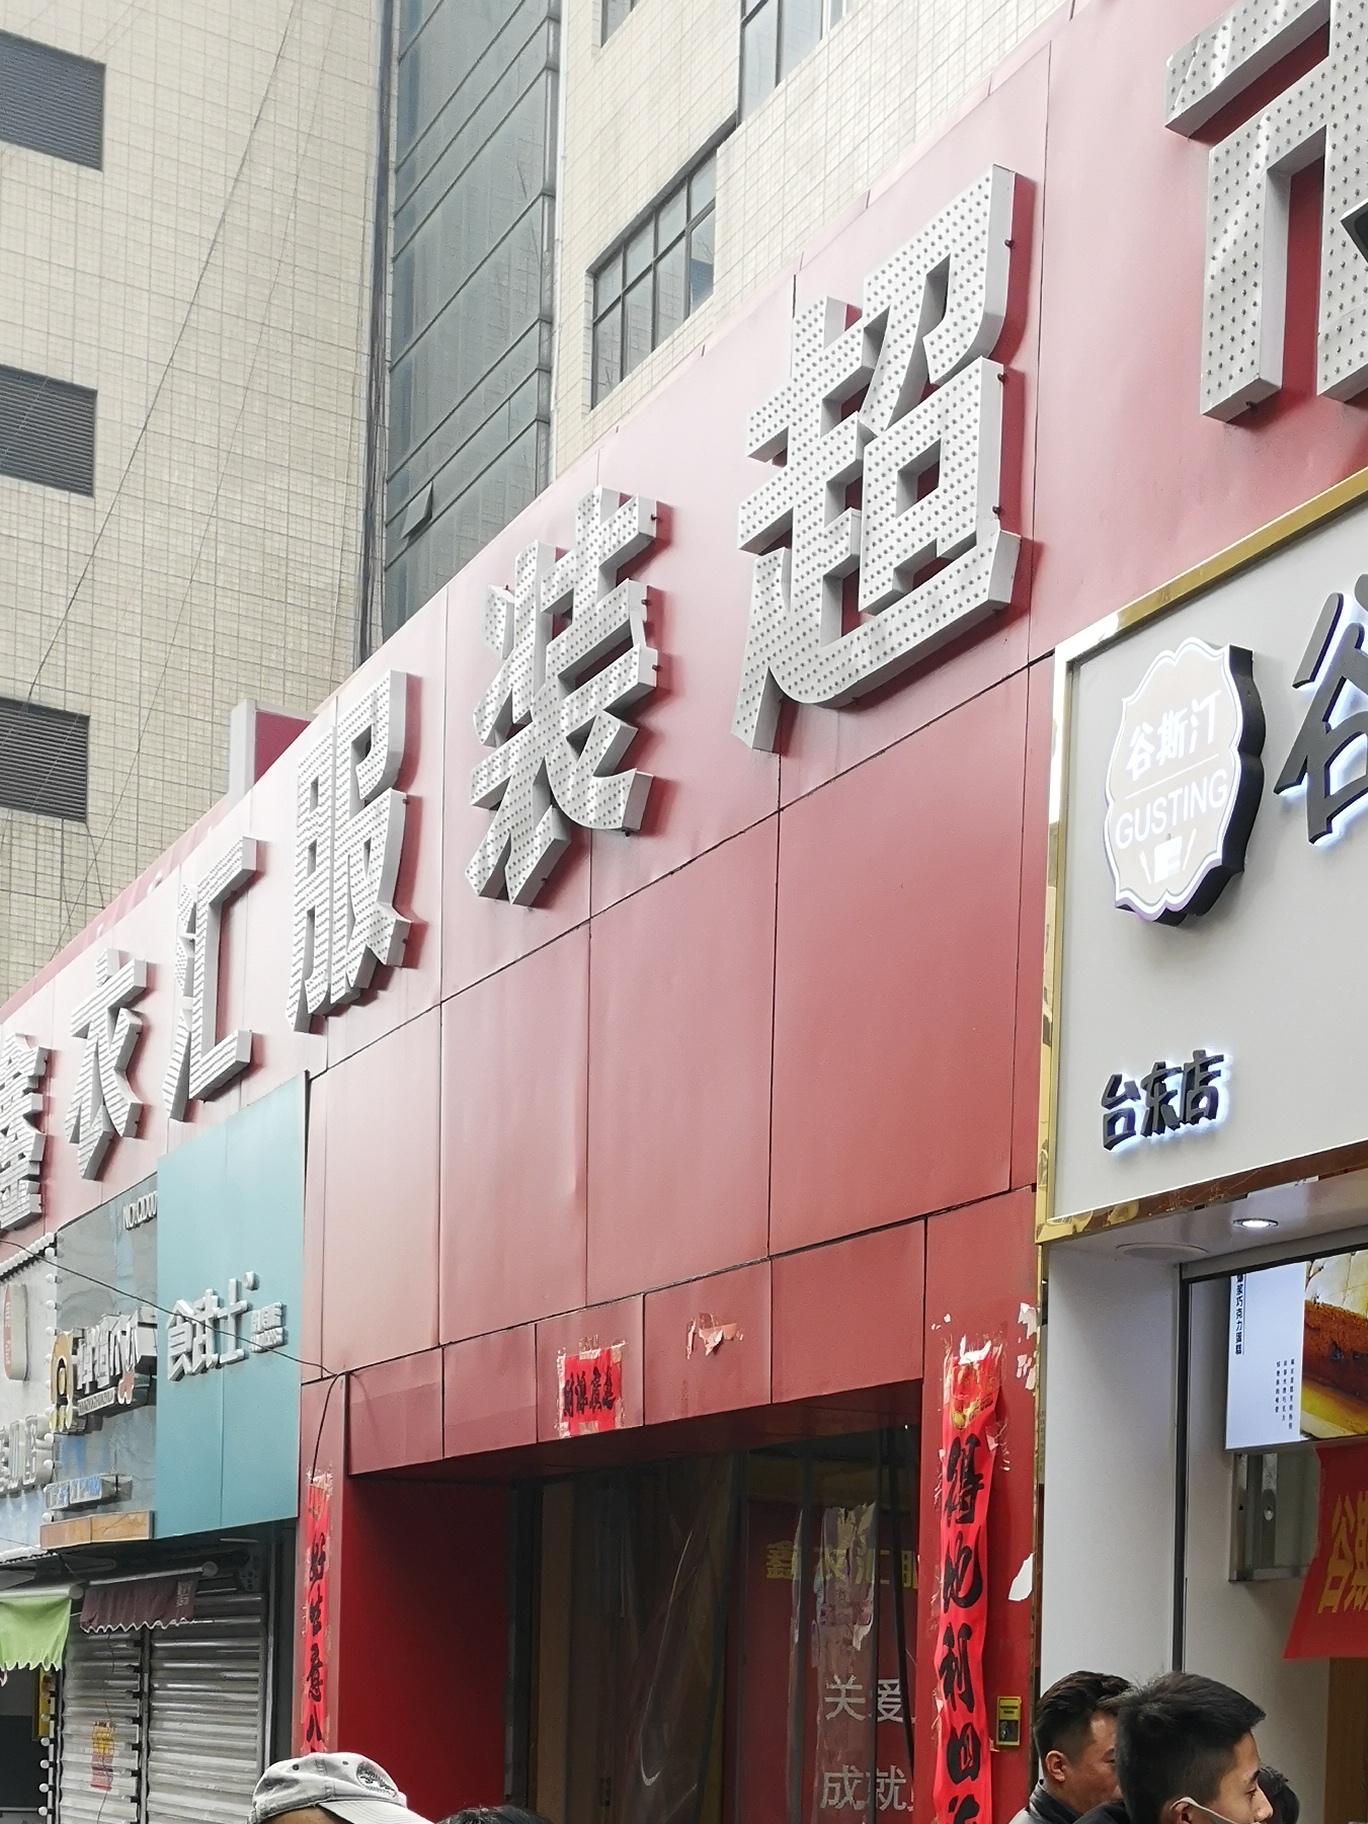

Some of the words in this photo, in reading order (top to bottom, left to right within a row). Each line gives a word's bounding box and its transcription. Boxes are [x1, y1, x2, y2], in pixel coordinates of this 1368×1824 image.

[1126, 688, 1222, 780] 谷斯汀
[1115, 770, 1228, 850] GUSTING
[1102, 1049, 1226, 1152] 台东店
